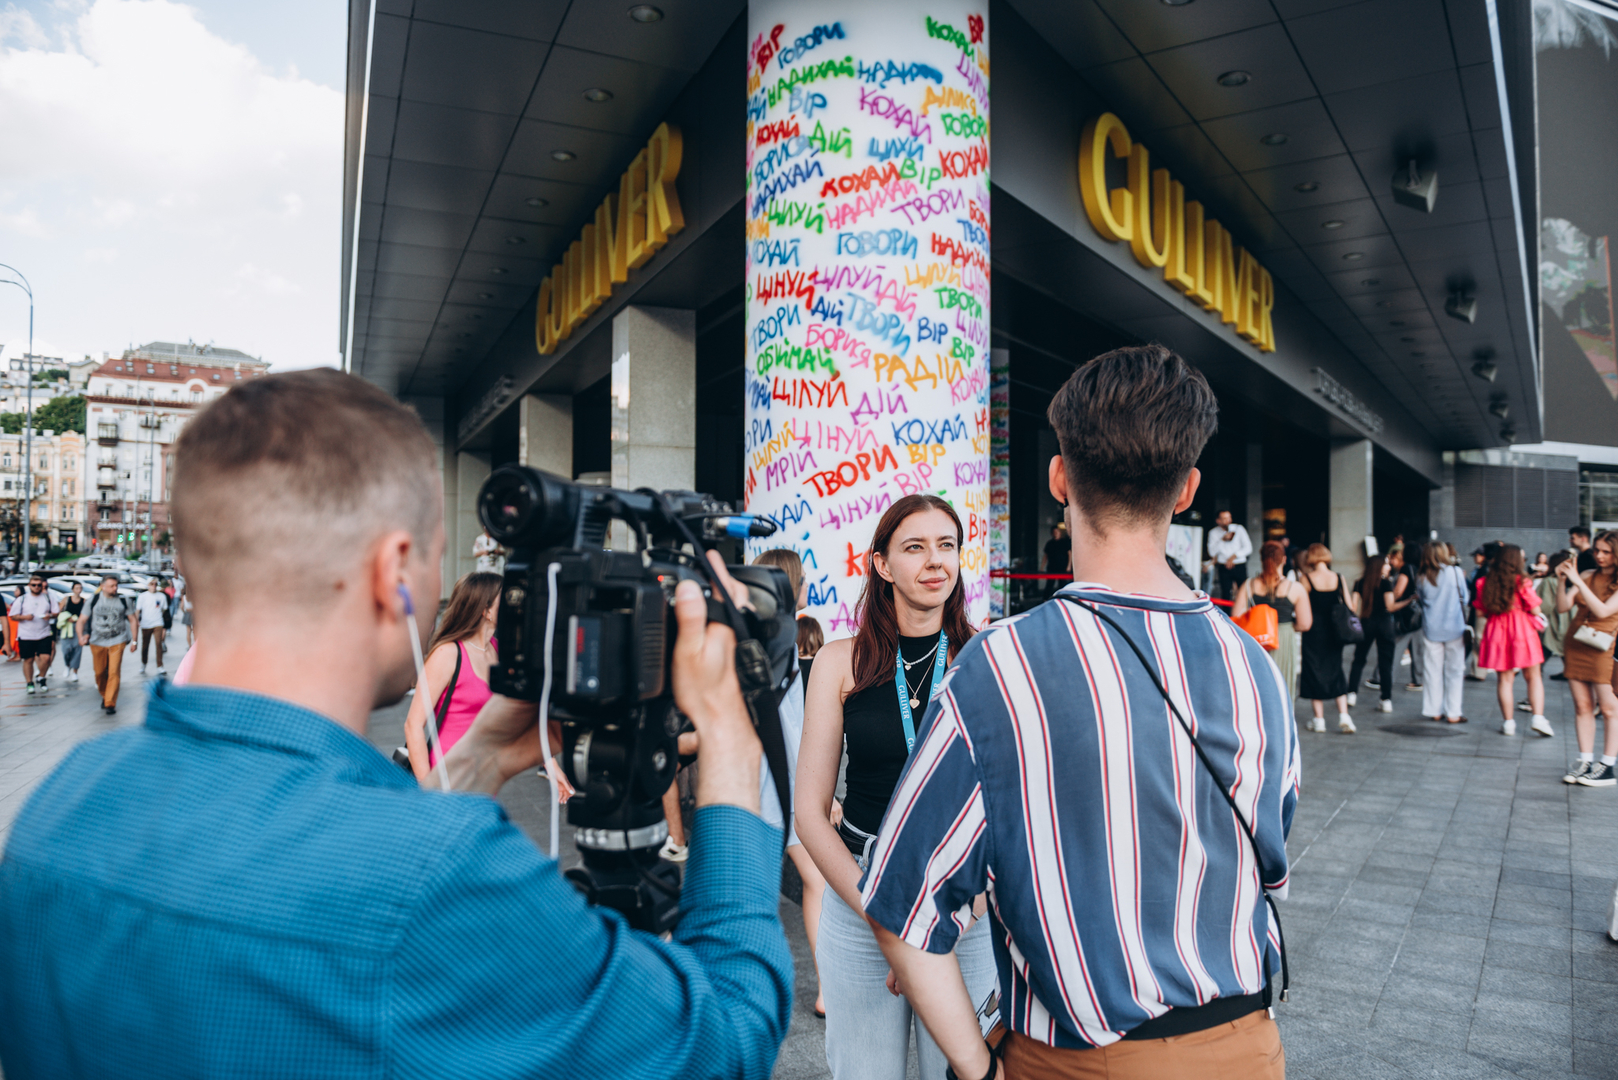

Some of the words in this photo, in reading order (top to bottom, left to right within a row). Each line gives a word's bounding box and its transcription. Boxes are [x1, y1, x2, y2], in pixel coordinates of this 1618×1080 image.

[778, 22, 845, 68] ГОВОРИ
[788, 86, 827, 118] ВІР
[859, 86, 932, 144] КОХАЙ
[900, 158, 942, 190] ВІР
[824, 180, 918, 229] НАДИХАЙ
[890, 188, 965, 226] ТВОРИ
[535, 121, 686, 355] GULLIVER
[837, 228, 918, 260] ГОВОРИ
[1078, 111, 1276, 353] GULLIVER
[933, 286, 982, 319] ТВОРИ
[749, 303, 801, 353] ТВОРИ
[917, 317, 948, 344] ВІР
[952, 336, 975, 368] ВІР
[772, 370, 849, 409] ЦІЛУЙ
[850, 383, 908, 425] ДІЙ
[792, 417, 879, 454] ЦІНУЙ
[891, 413, 968, 446] КОХАЙ
[802, 444, 898, 498] ТВОРИ
[907, 443, 946, 466] ВІР
[894, 462, 933, 497] ВІР
[820, 482, 892, 529] ЦІНУЙ
[969, 513, 987, 547] ВІР
[937, 634, 949, 667] GULLIVER
[898, 684, 910, 720] GULLIVER
